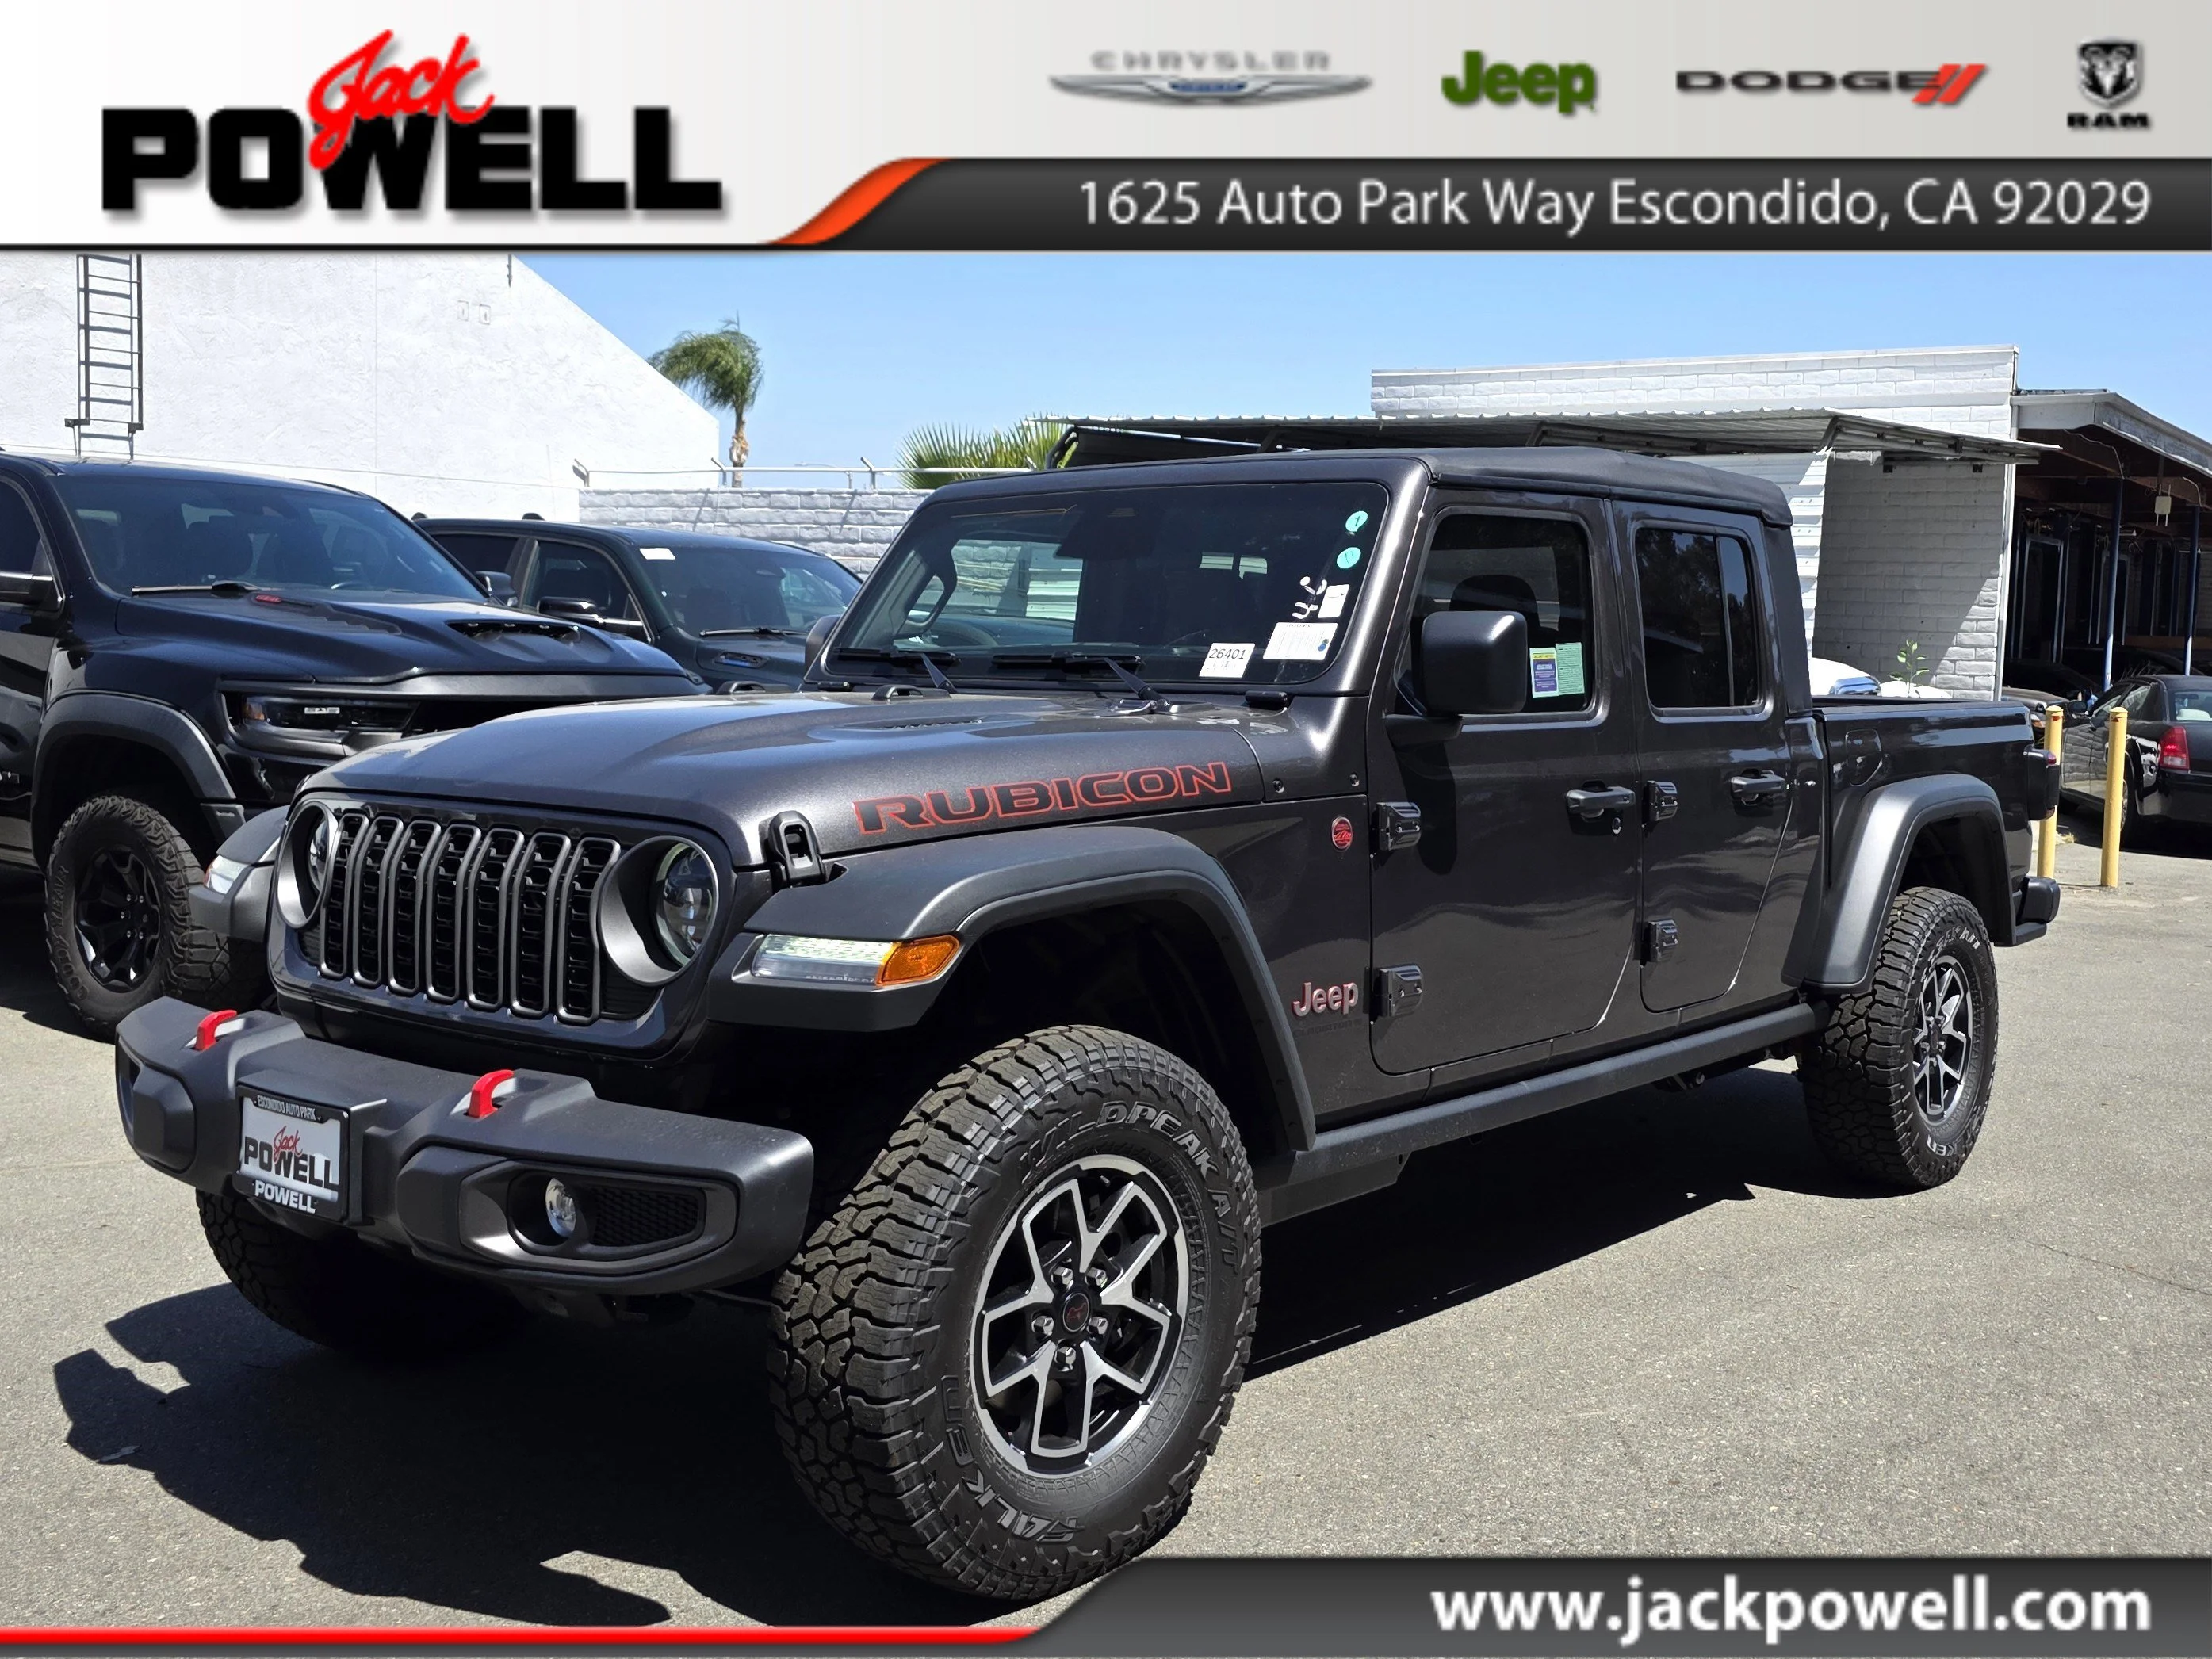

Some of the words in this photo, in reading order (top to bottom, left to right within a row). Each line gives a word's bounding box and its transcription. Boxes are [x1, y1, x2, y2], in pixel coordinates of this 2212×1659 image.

[1209, 648, 1246, 659] 26401
[852, 762, 1232, 835] RUBICON
[1292, 981, 1359, 1017] Jeep
[257, 1095, 285, 1114] ESCONDIDO
[285, 1102, 300, 1118] AUTO
[300, 1107, 316, 1121] PARK
[243, 1136, 339, 1189] POWELL
[273, 1125, 304, 1164] Jack
[254, 1179, 316, 1214] POWELL
